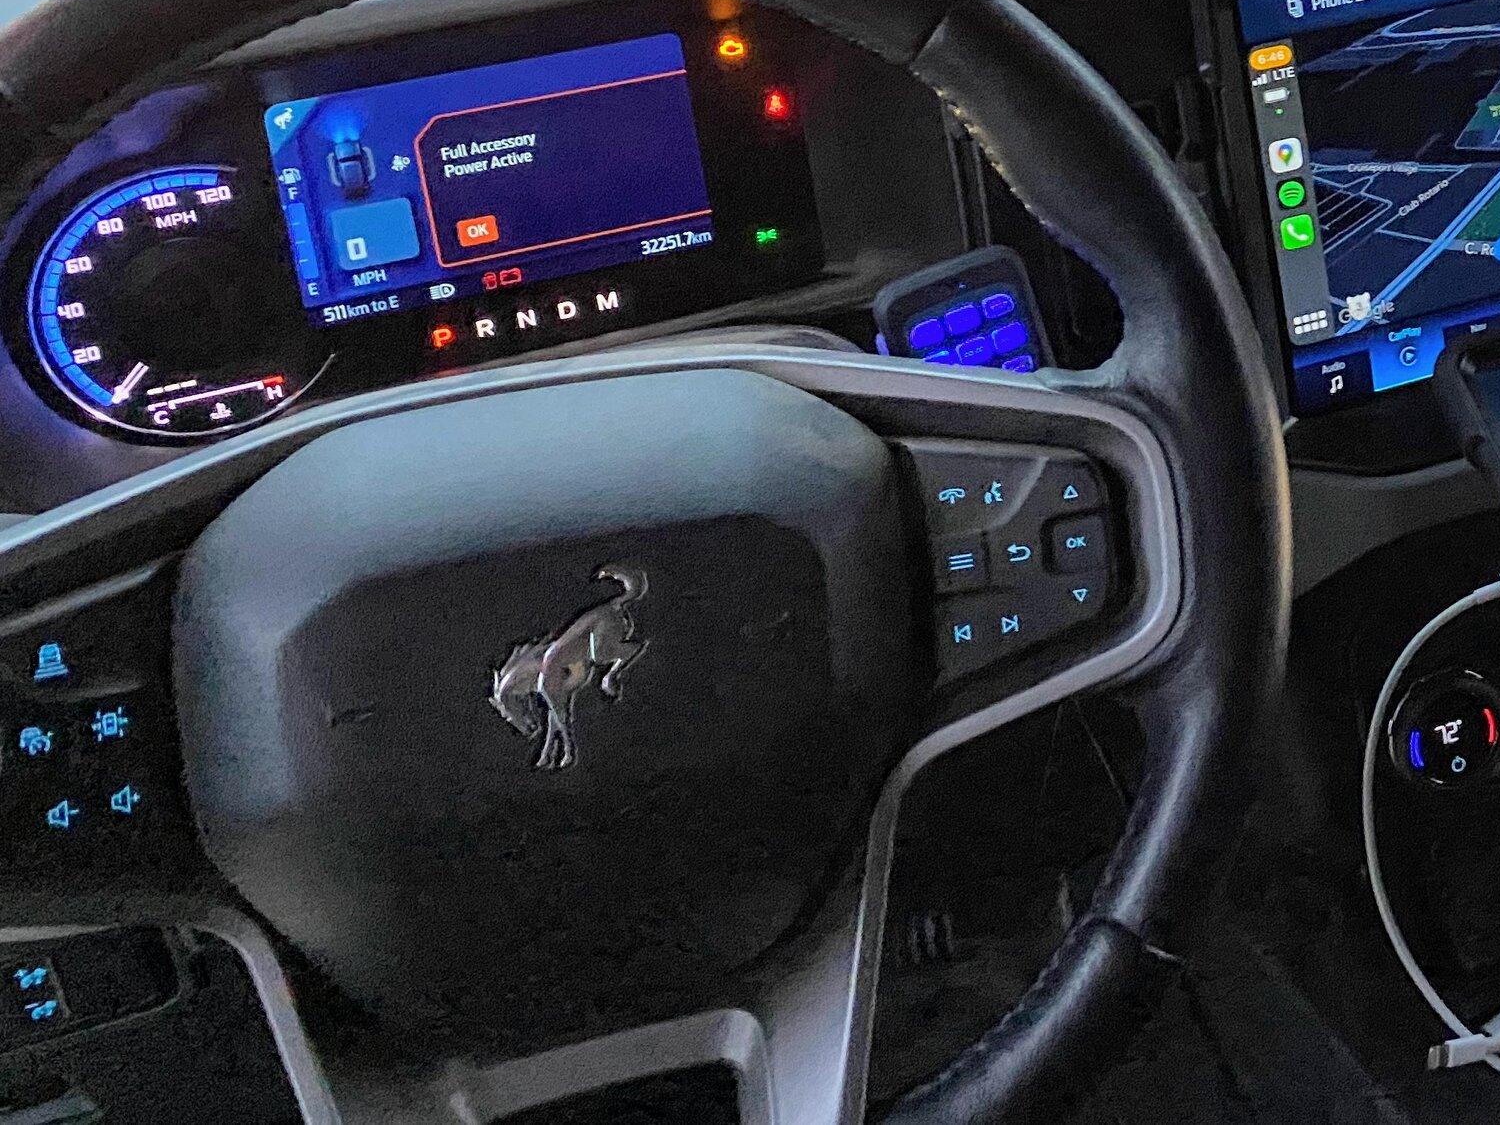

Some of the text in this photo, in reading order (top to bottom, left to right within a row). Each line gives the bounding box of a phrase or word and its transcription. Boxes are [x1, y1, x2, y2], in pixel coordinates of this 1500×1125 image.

[1257, 51, 1285, 65] 6:46
[1273, 67, 1295, 81] LTE
[441, 133, 536, 161] Full Accessory
[444, 151, 534, 178] Power Active
[141, 192, 177, 211] 100
[196, 185, 232, 204] 120
[287, 187, 298, 200] F
[1399, 200, 1419, 216] Club
[97, 217, 124, 235] 80
[155, 210, 198, 230] MPH
[466, 223, 489, 239] OK
[346, 236, 368, 261] 0
[1465, 242, 1478, 255] C.
[65, 256, 93, 274] 60
[352, 269, 387, 287] MPH
[307, 283, 319, 296] E
[57, 302, 85, 319] 40
[372, 300, 388, 312] to
[389, 295, 400, 309] E
[1338, 300, 1395, 324] Ggle
[433, 291, 619, 349] P R N D M
[73, 346, 101, 363] 20
[1321, 361, 1346, 375] Audio
[267, 386, 283, 400] H
[153, 411, 171, 426] C
[1065, 536, 1087, 549] OK
